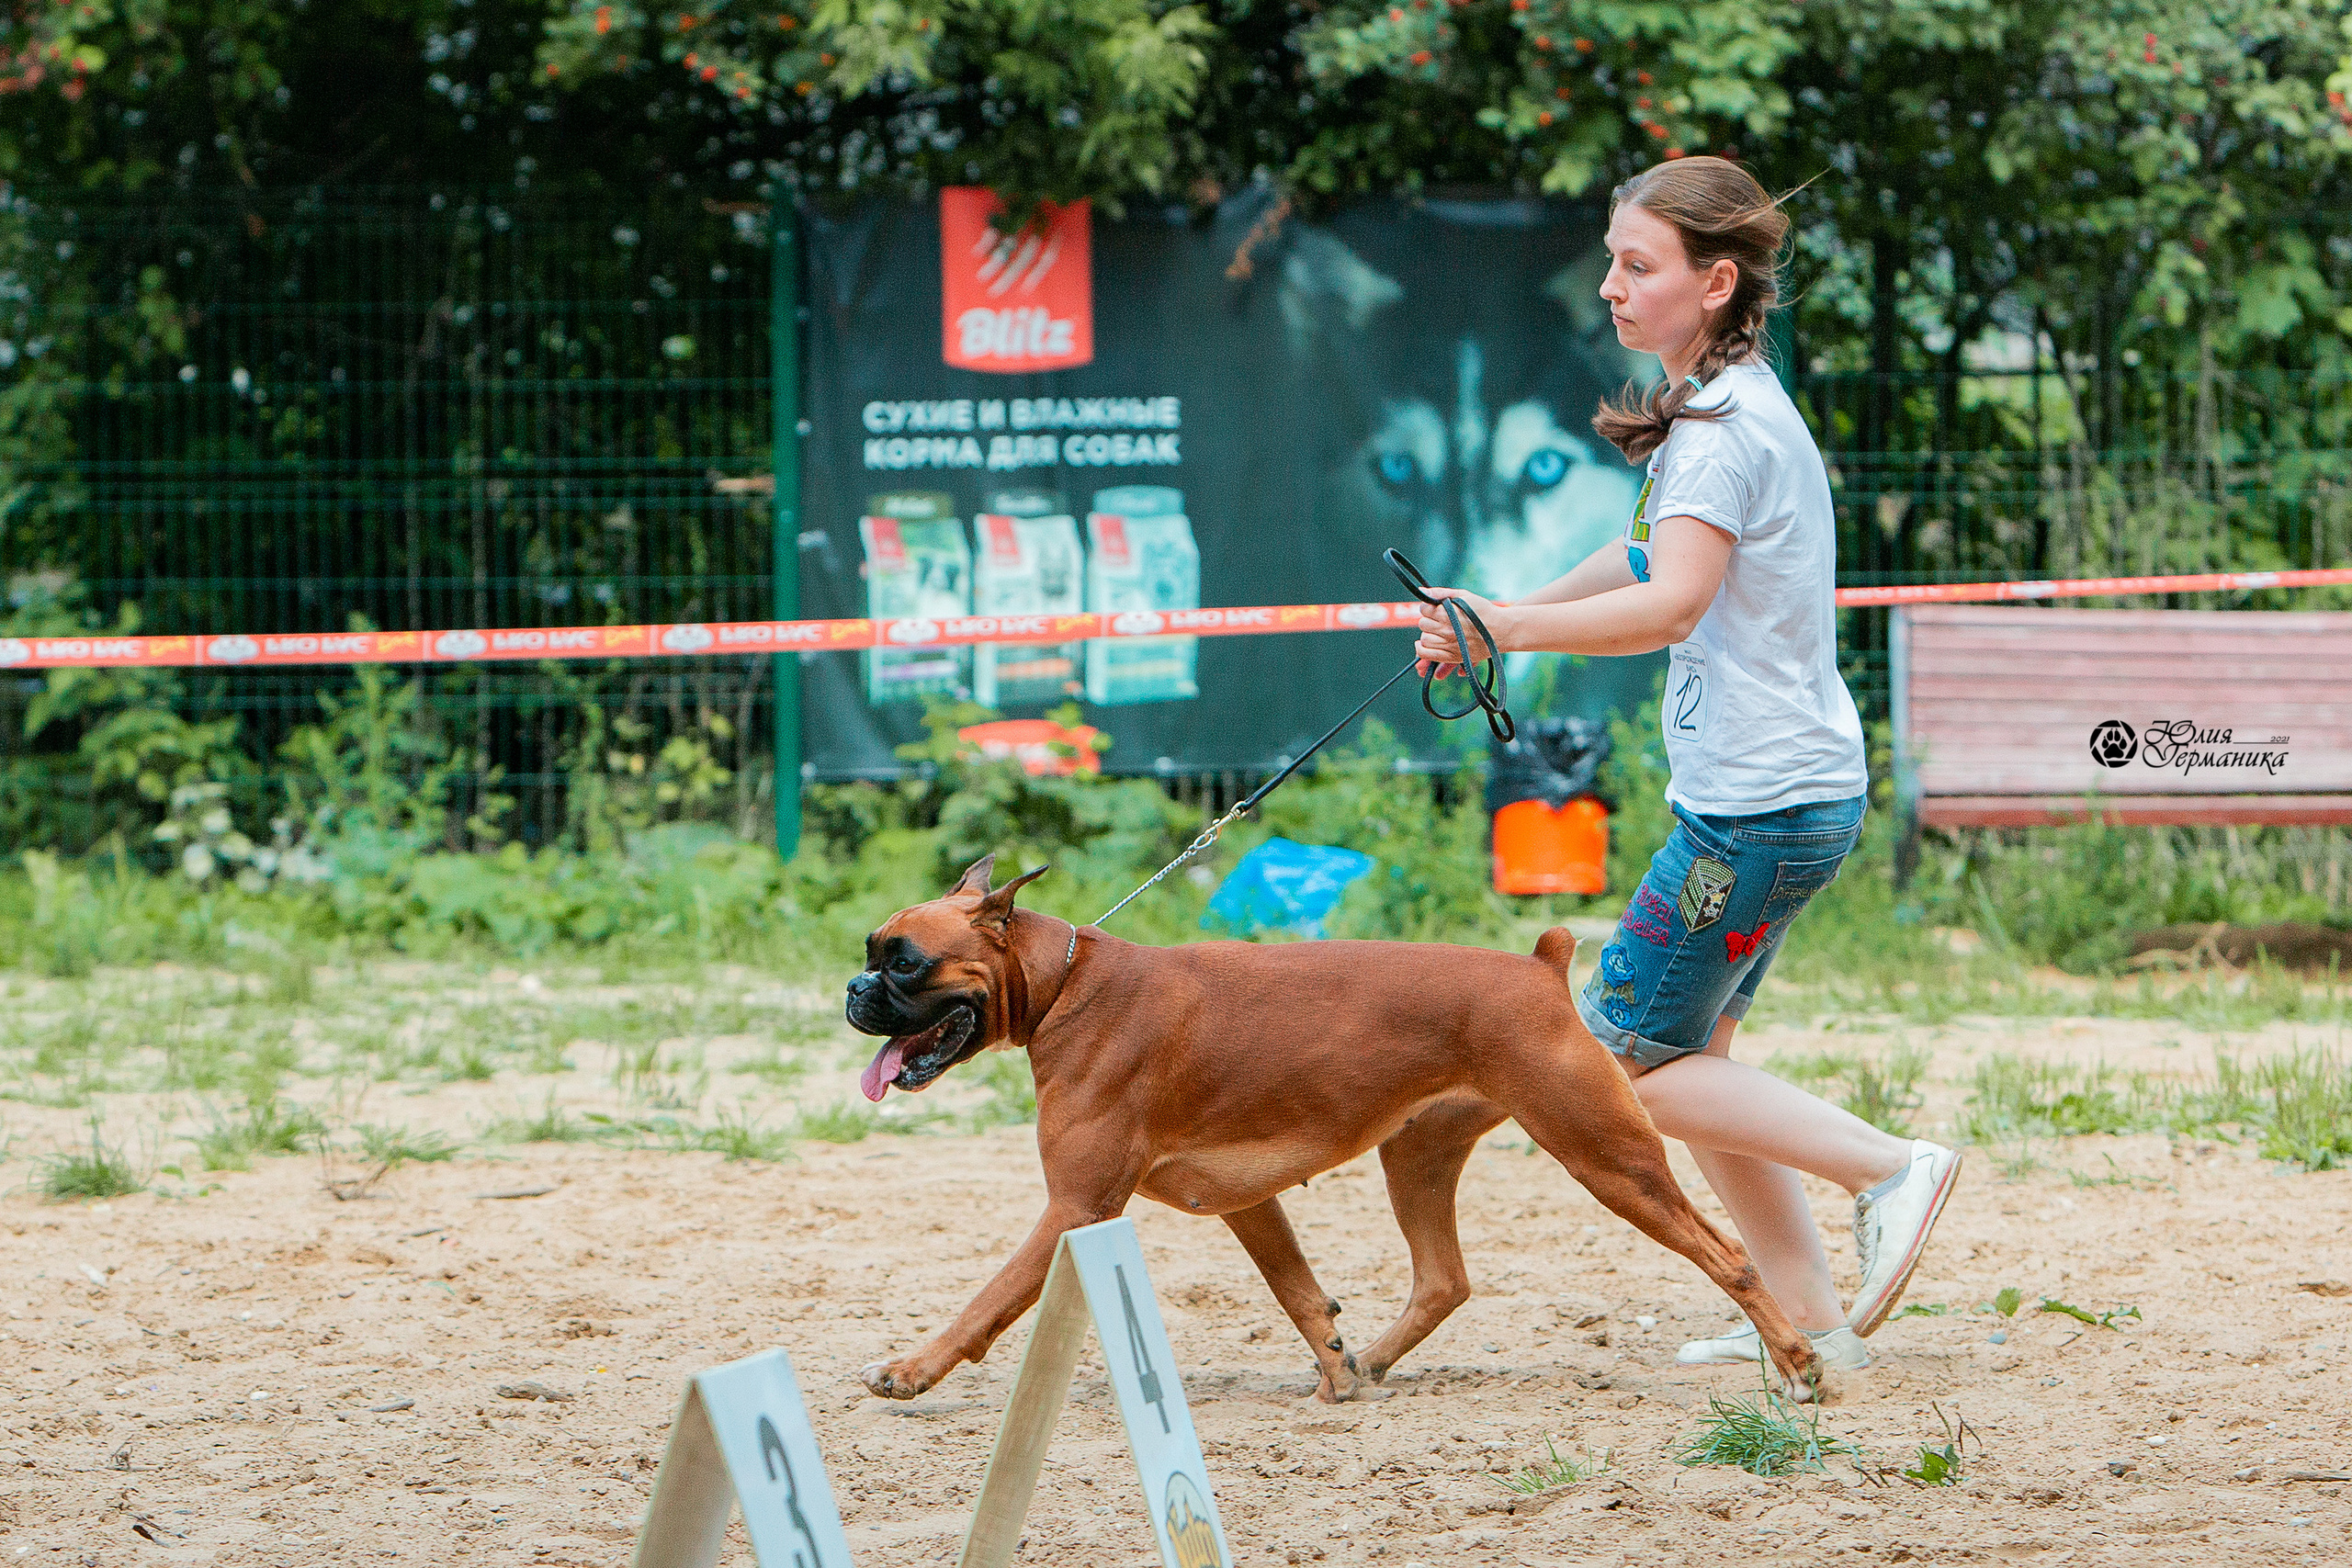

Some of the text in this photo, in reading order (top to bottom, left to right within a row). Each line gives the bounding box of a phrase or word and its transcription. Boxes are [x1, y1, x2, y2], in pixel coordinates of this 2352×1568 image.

[956, 307, 1075, 357] Blitz
[863, 397, 1182, 433] СУХИЕ И ВЛАЖНЫЕ
[863, 434, 1182, 471] КОРМА ДЛЯ СОБАК
[1674, 672, 1702, 731] 12
[1114, 1264, 1170, 1433] 4
[756, 1413, 823, 1568] 3
